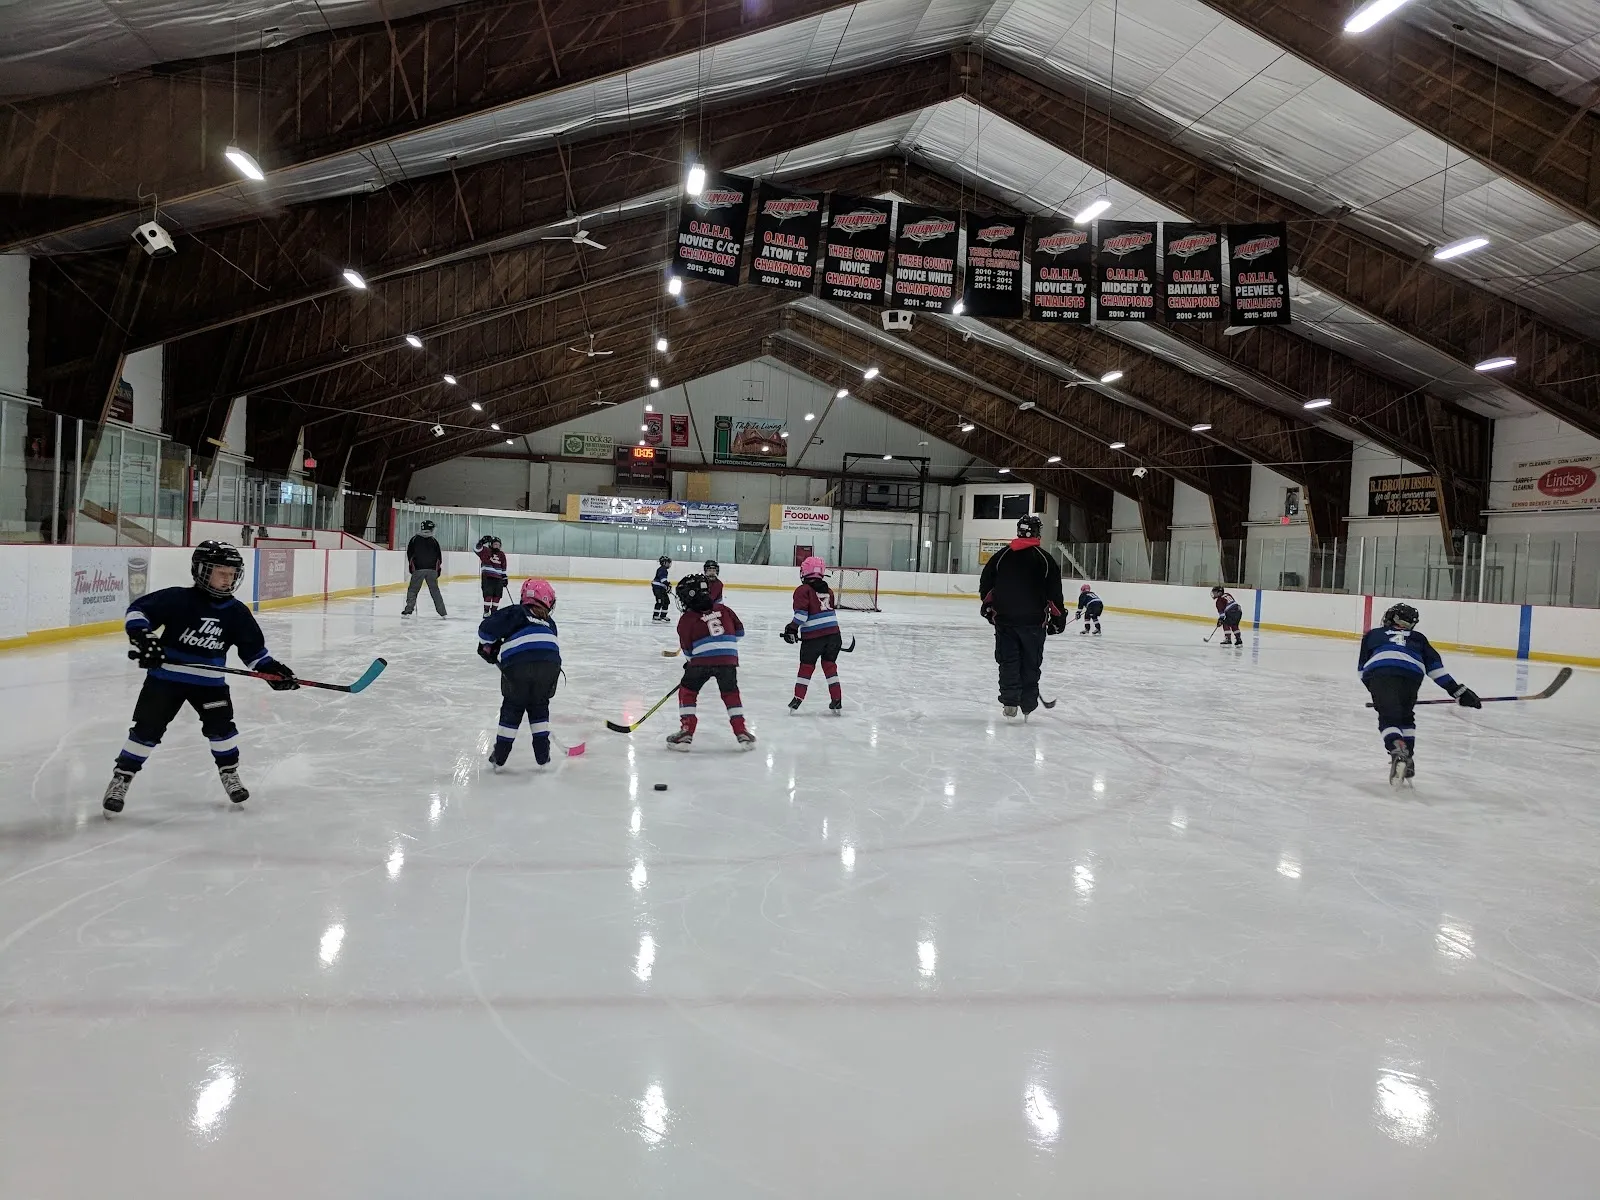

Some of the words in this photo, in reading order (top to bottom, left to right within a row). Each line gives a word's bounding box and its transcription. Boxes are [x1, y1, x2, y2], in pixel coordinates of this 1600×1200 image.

[690, 221, 733, 240] O.M.H.A.
[679, 233, 713, 249] NOVICE
[716, 240, 740, 254] C/CC
[763, 231, 809, 250] O.M.H.A.
[680, 246, 736, 267] CHAMPIONS
[762, 246, 792, 261] ATOM
[828, 244, 853, 259] THREE
[854, 248, 885, 263] COUNTY
[969, 247, 992, 257] THREE
[993, 249, 1020, 260] COUNTY
[687, 263, 702, 273] 2015
[754, 257, 812, 278] CHAMPIONS
[840, 261, 870, 274] NOVICE
[898, 254, 922, 268] THREE
[923, 257, 953, 271] COUNTY
[985, 258, 1020, 270] CHAMPIONS
[897, 268, 926, 282] NOVICE
[928, 271, 953, 284] WHITE
[1040, 267, 1082, 281] O.M.H.A.
[1106, 268, 1148, 281] O.M.H.A.
[1172, 270, 1214, 282] O.M.H.A.
[1238, 272, 1277, 284] O.M.H.A.
[762, 275, 779, 285] 2010
[785, 279, 802, 288] 2011
[826, 272, 882, 290] CHAMPIONS
[1035, 282, 1072, 293] NOVICE
[1102, 282, 1139, 293] MIDGET
[833, 289, 872, 300] 2012-2013
[896, 281, 951, 298] CHAMPIONS
[1168, 284, 1207, 295] BANTAM
[1235, 285, 1274, 297] PEEWEE
[1277, 284, 1284, 295] C
[925, 300, 942, 308] 2012
[1035, 295, 1085, 308] FINALISTS
[1101, 295, 1153, 307] CHAMPIONS
[1168, 296, 1220, 309] CHAMPIONS
[1236, 297, 1282, 309] FINALISTS
[633, 448, 654, 458] 10:05
[1546, 472, 1588, 488] Lindsay
[784, 510, 830, 521] FOODLAND
[74, 570, 91, 595] Tim
[91, 569, 124, 592] Hortons
[200, 617, 223, 636] Tim
[707, 619, 725, 636] 6
[179, 627, 223, 650] Hortons
